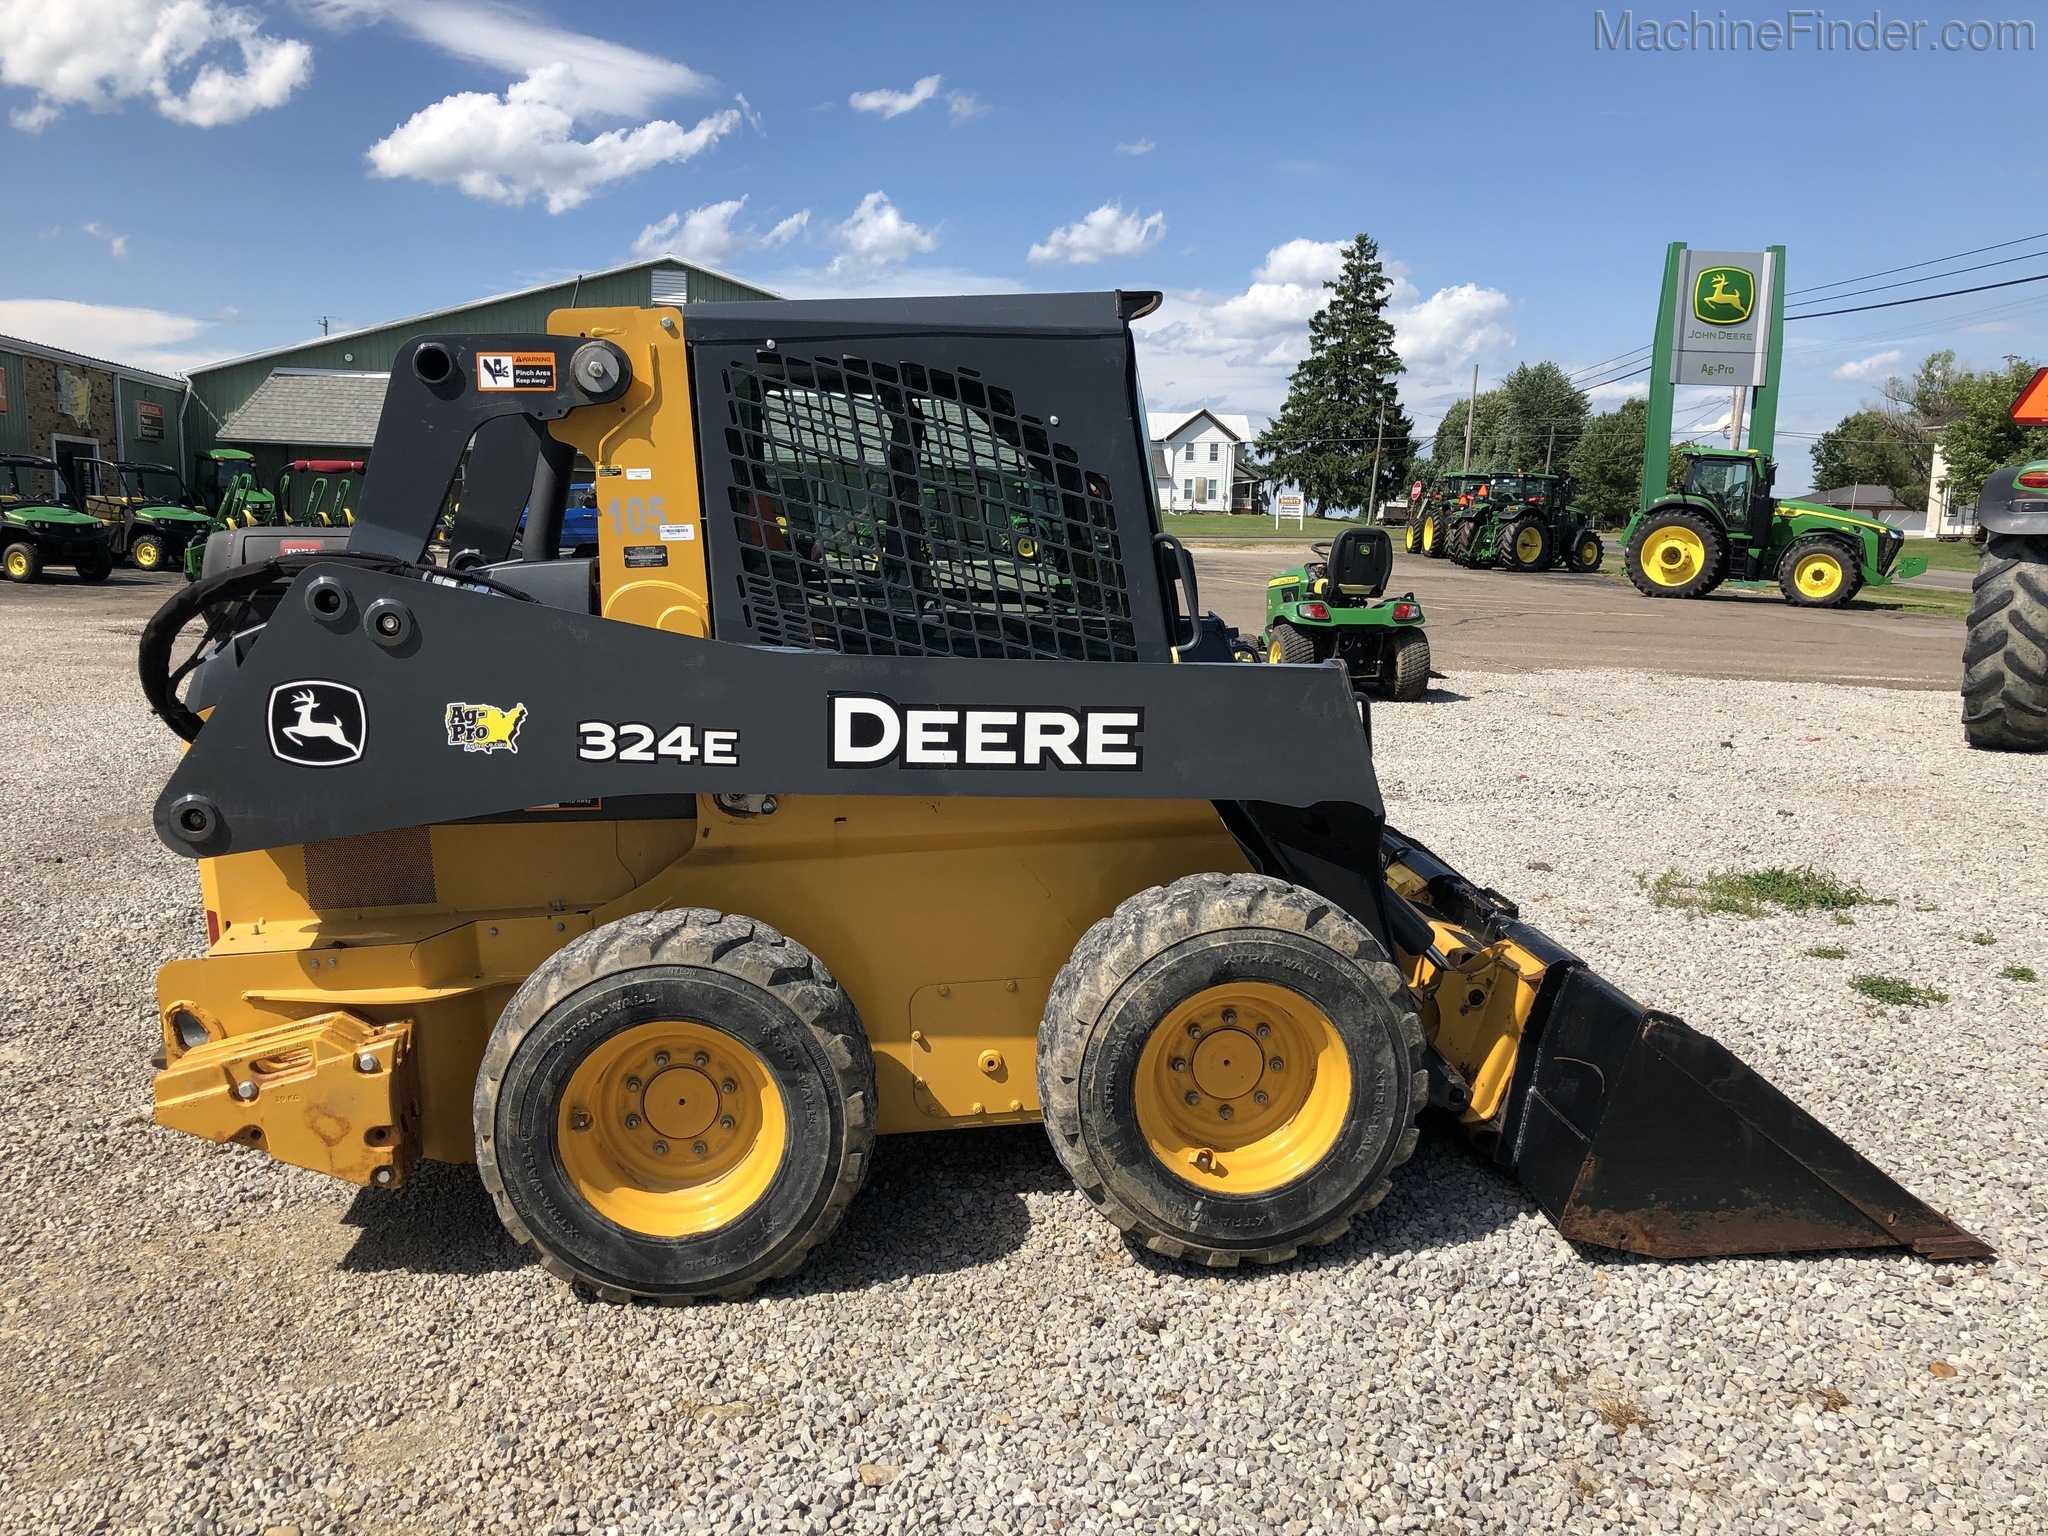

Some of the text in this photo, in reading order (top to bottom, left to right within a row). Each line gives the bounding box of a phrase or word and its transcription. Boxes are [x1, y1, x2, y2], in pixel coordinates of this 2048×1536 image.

[1688, 330, 1753, 340] JOHN DEERE
[1701, 364, 1735, 375] Ag-Pro
[607, 495, 668, 537] 105
[450, 706, 486, 726] Ag-
[451, 725, 488, 742] Pro
[834, 696, 1139, 765] DEERE
[579, 722, 738, 765] 324E
[557, 993, 656, 1048] XTRA-WALL
[801, 1028, 837, 1096] SOLIDEAL
